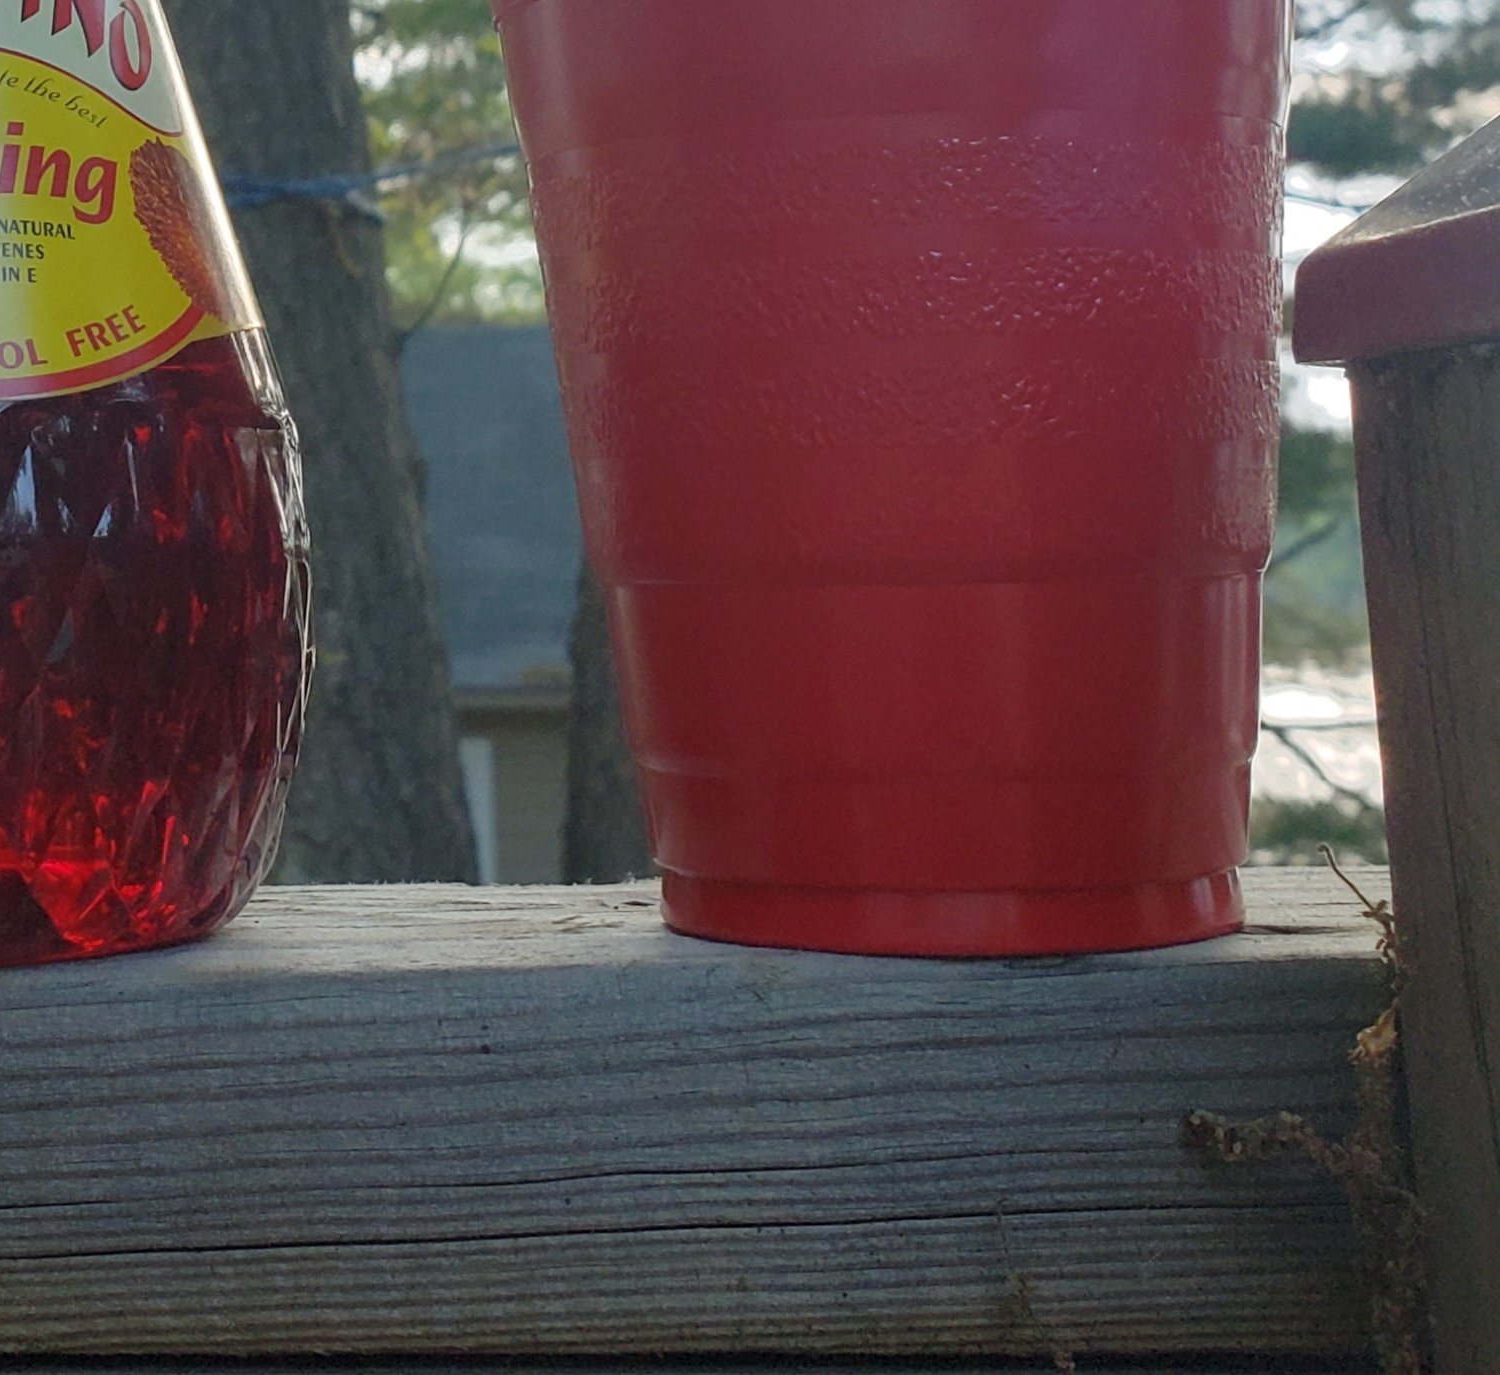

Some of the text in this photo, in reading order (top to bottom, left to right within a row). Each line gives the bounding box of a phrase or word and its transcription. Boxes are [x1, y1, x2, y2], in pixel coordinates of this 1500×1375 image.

[23, 76, 61, 102] the
[65, 95, 108, 128] best
[27, 267, 38, 284] E
[65, 305, 147, 357] FREE
